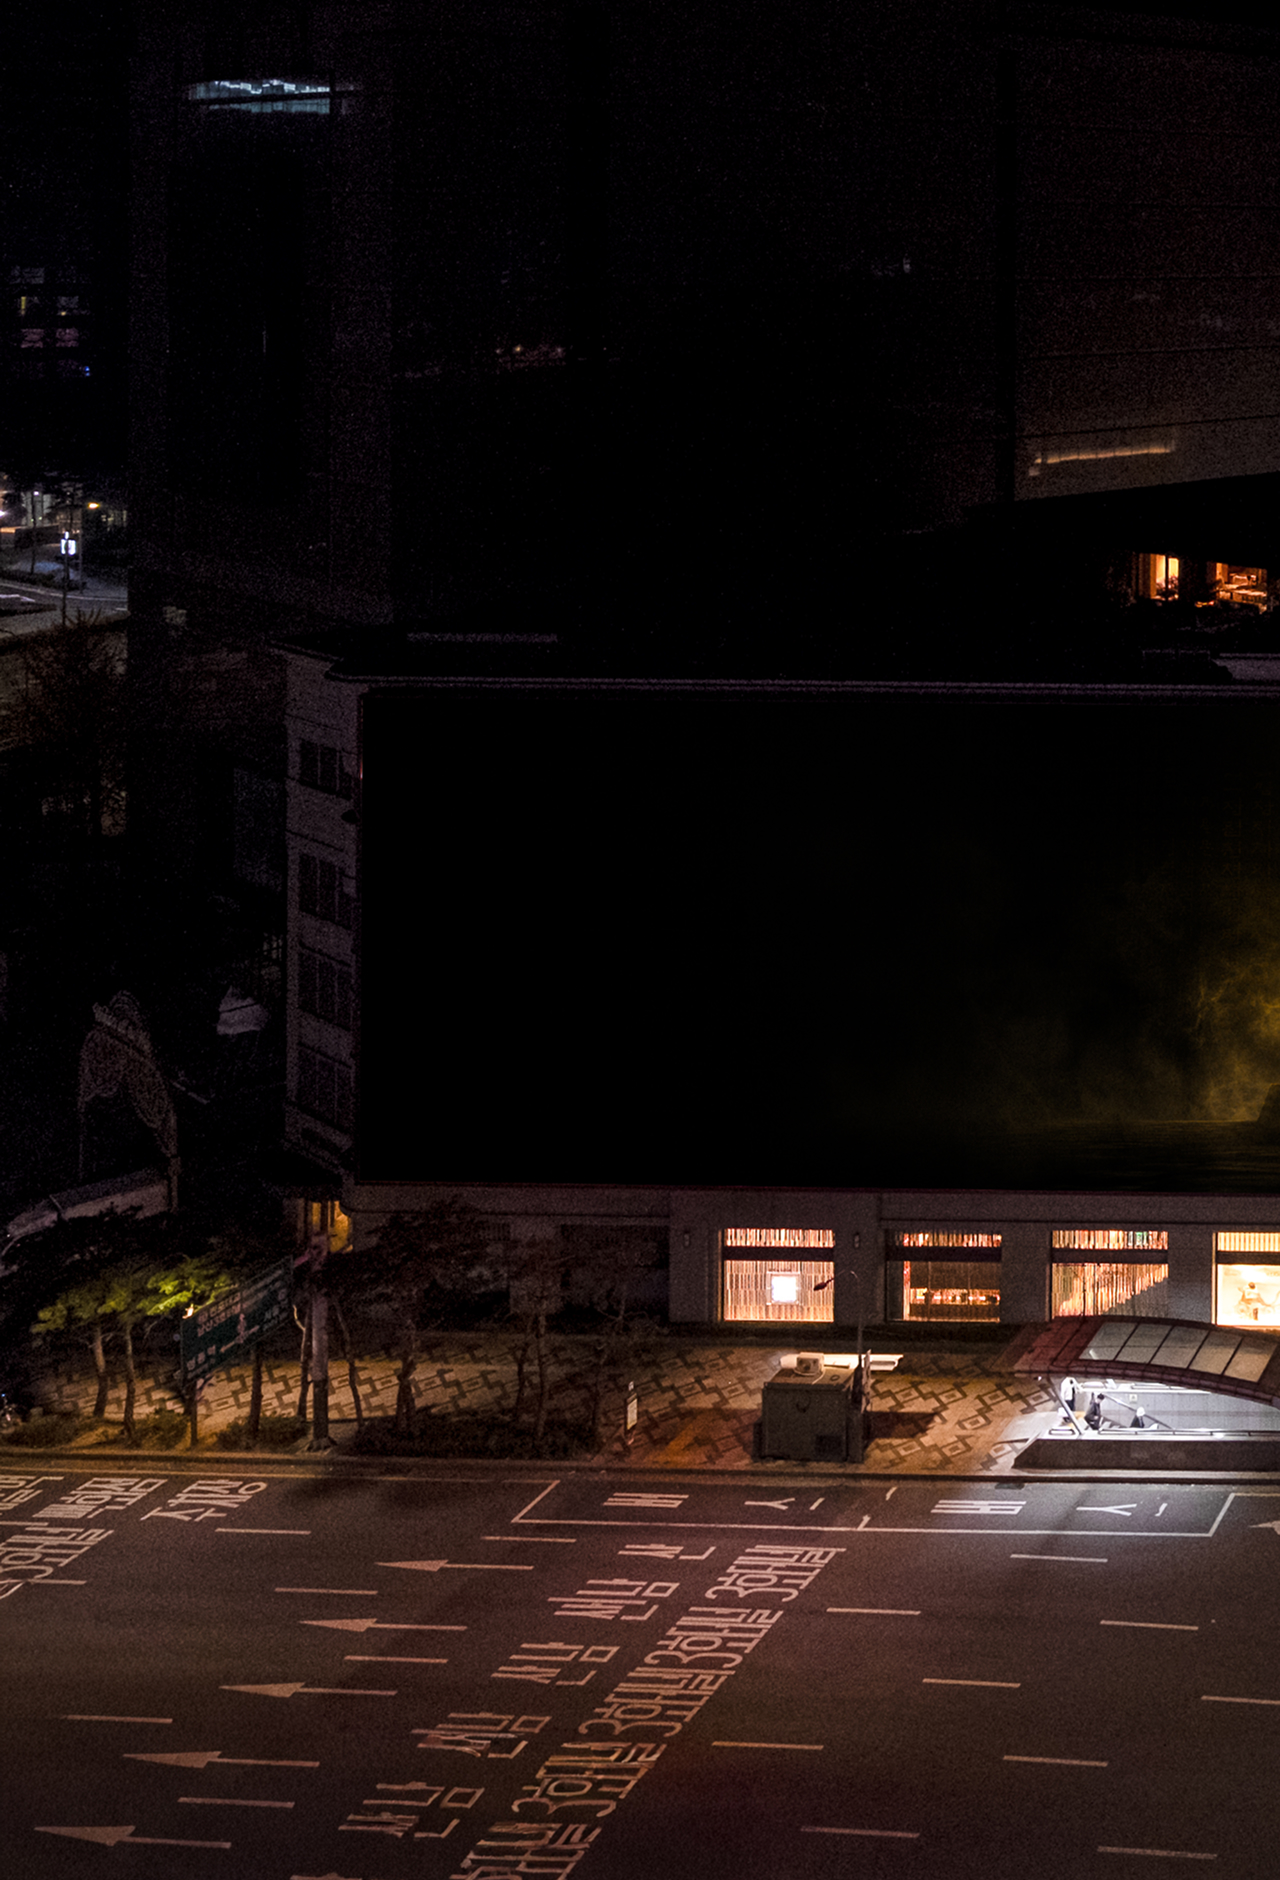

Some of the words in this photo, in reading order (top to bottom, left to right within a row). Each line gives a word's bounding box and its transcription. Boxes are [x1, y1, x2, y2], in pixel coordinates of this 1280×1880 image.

[32, 1477, 168, 1519] 백화점
[140, 1479, 268, 1522] 주차장
[603, 1492, 826, 1511] 버스
[930, 1499, 1168, 1518] 버스
[704, 1544, 847, 1602] 3호터널
[644, 1606, 785, 1669] 3호터널
[578, 1664, 737, 1739] 3호터널
[511, 1741, 668, 1818] 3호터널
